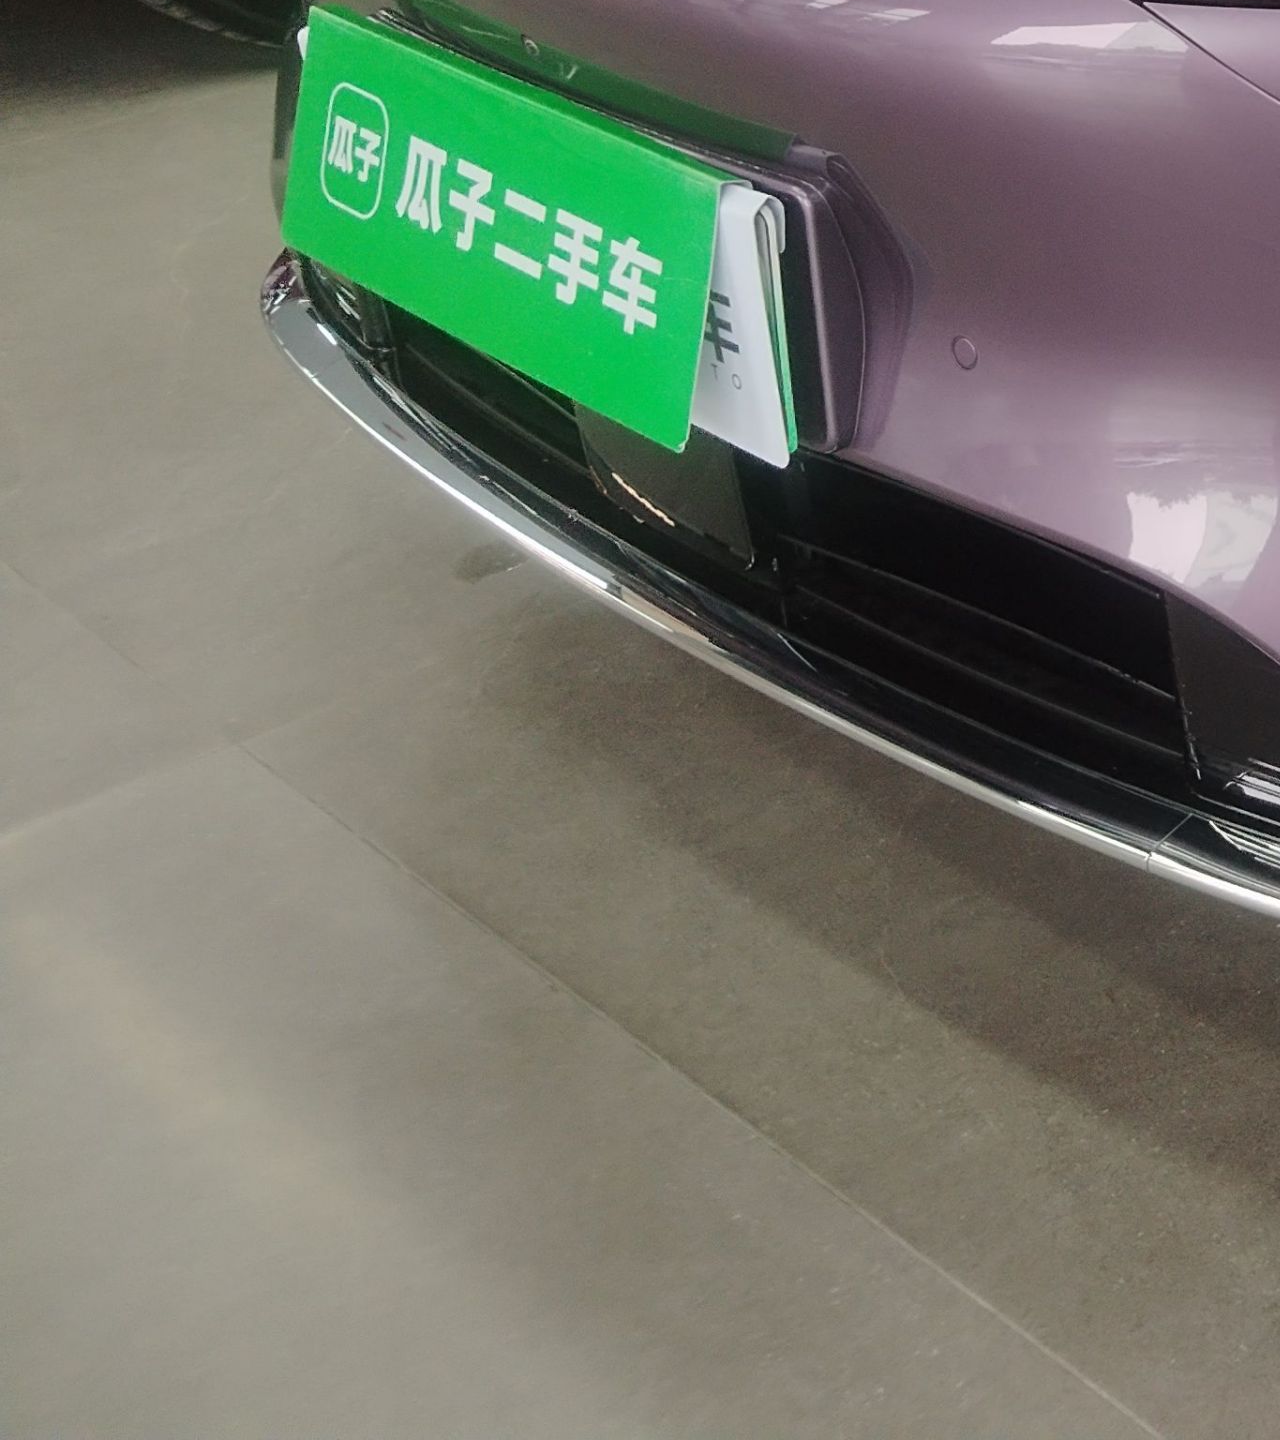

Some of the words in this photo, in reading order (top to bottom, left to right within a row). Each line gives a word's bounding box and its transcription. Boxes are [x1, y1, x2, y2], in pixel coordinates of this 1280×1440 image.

[327, 114, 382, 183] 瓜子
[394, 134, 664, 336] 瓜子二手车
